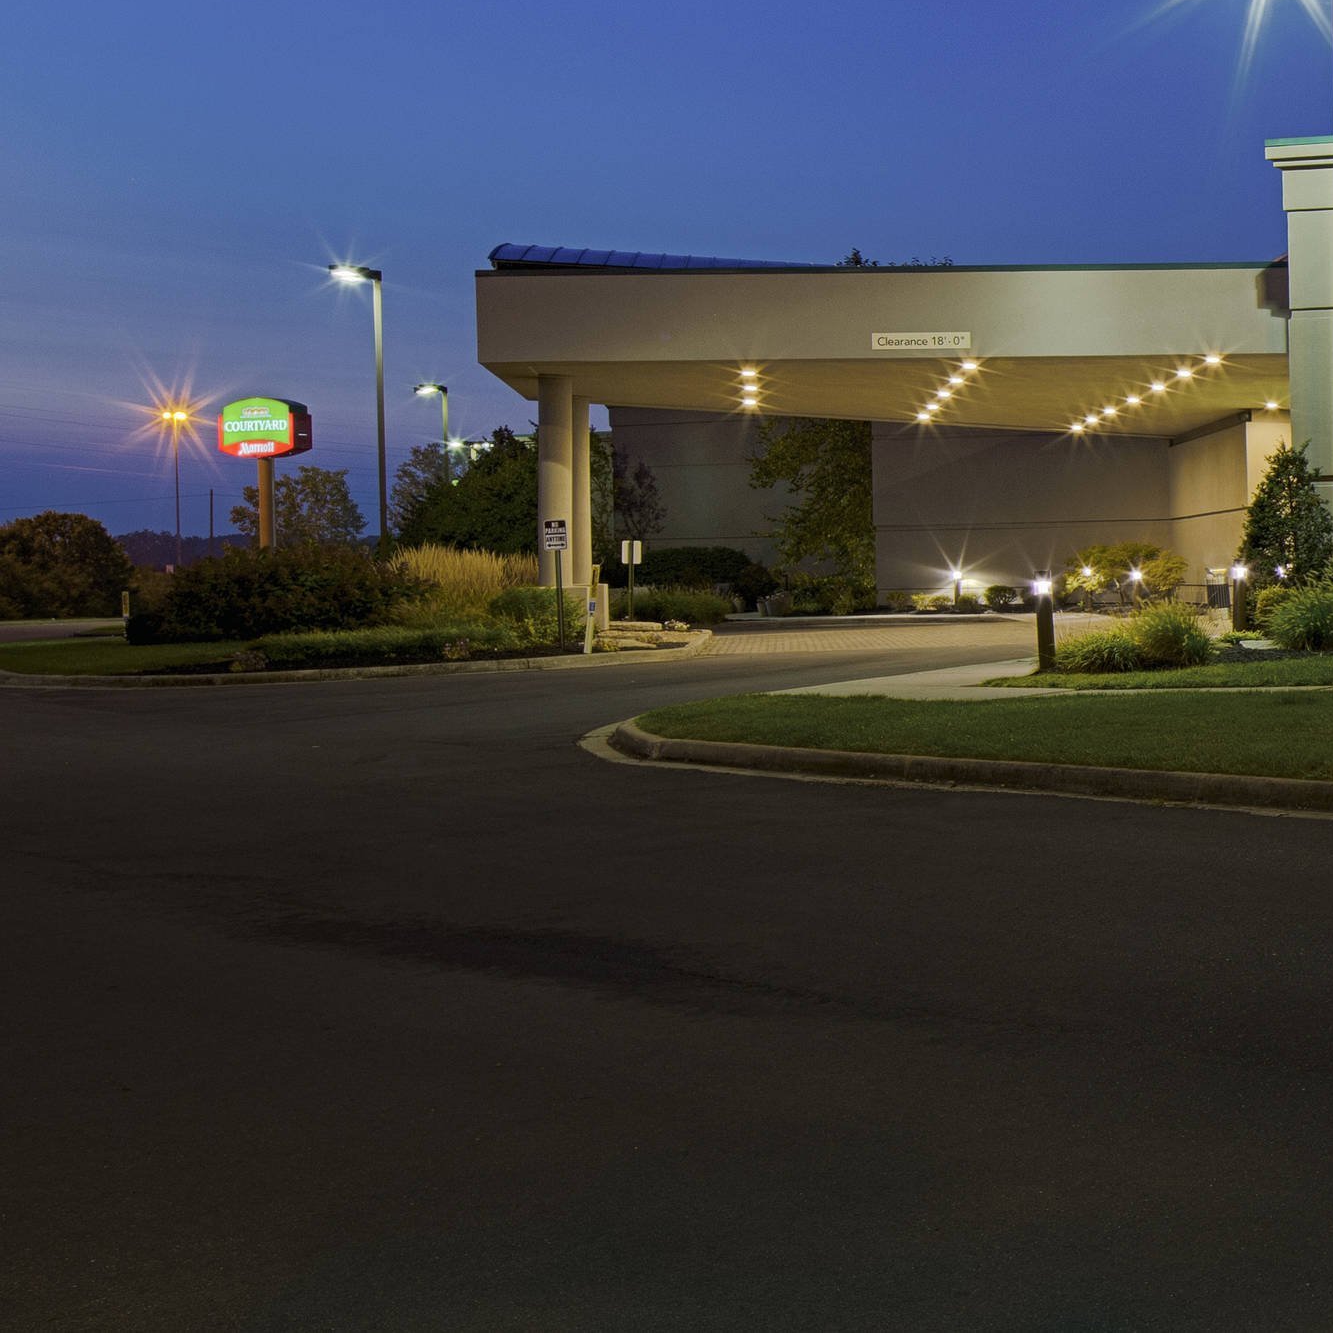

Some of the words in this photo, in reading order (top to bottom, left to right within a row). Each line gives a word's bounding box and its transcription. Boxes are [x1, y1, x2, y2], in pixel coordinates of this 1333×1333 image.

[877, 336, 928, 347] Clearance
[224, 419, 288, 433] COURTYARD
[238, 441, 275, 457] Marriott
